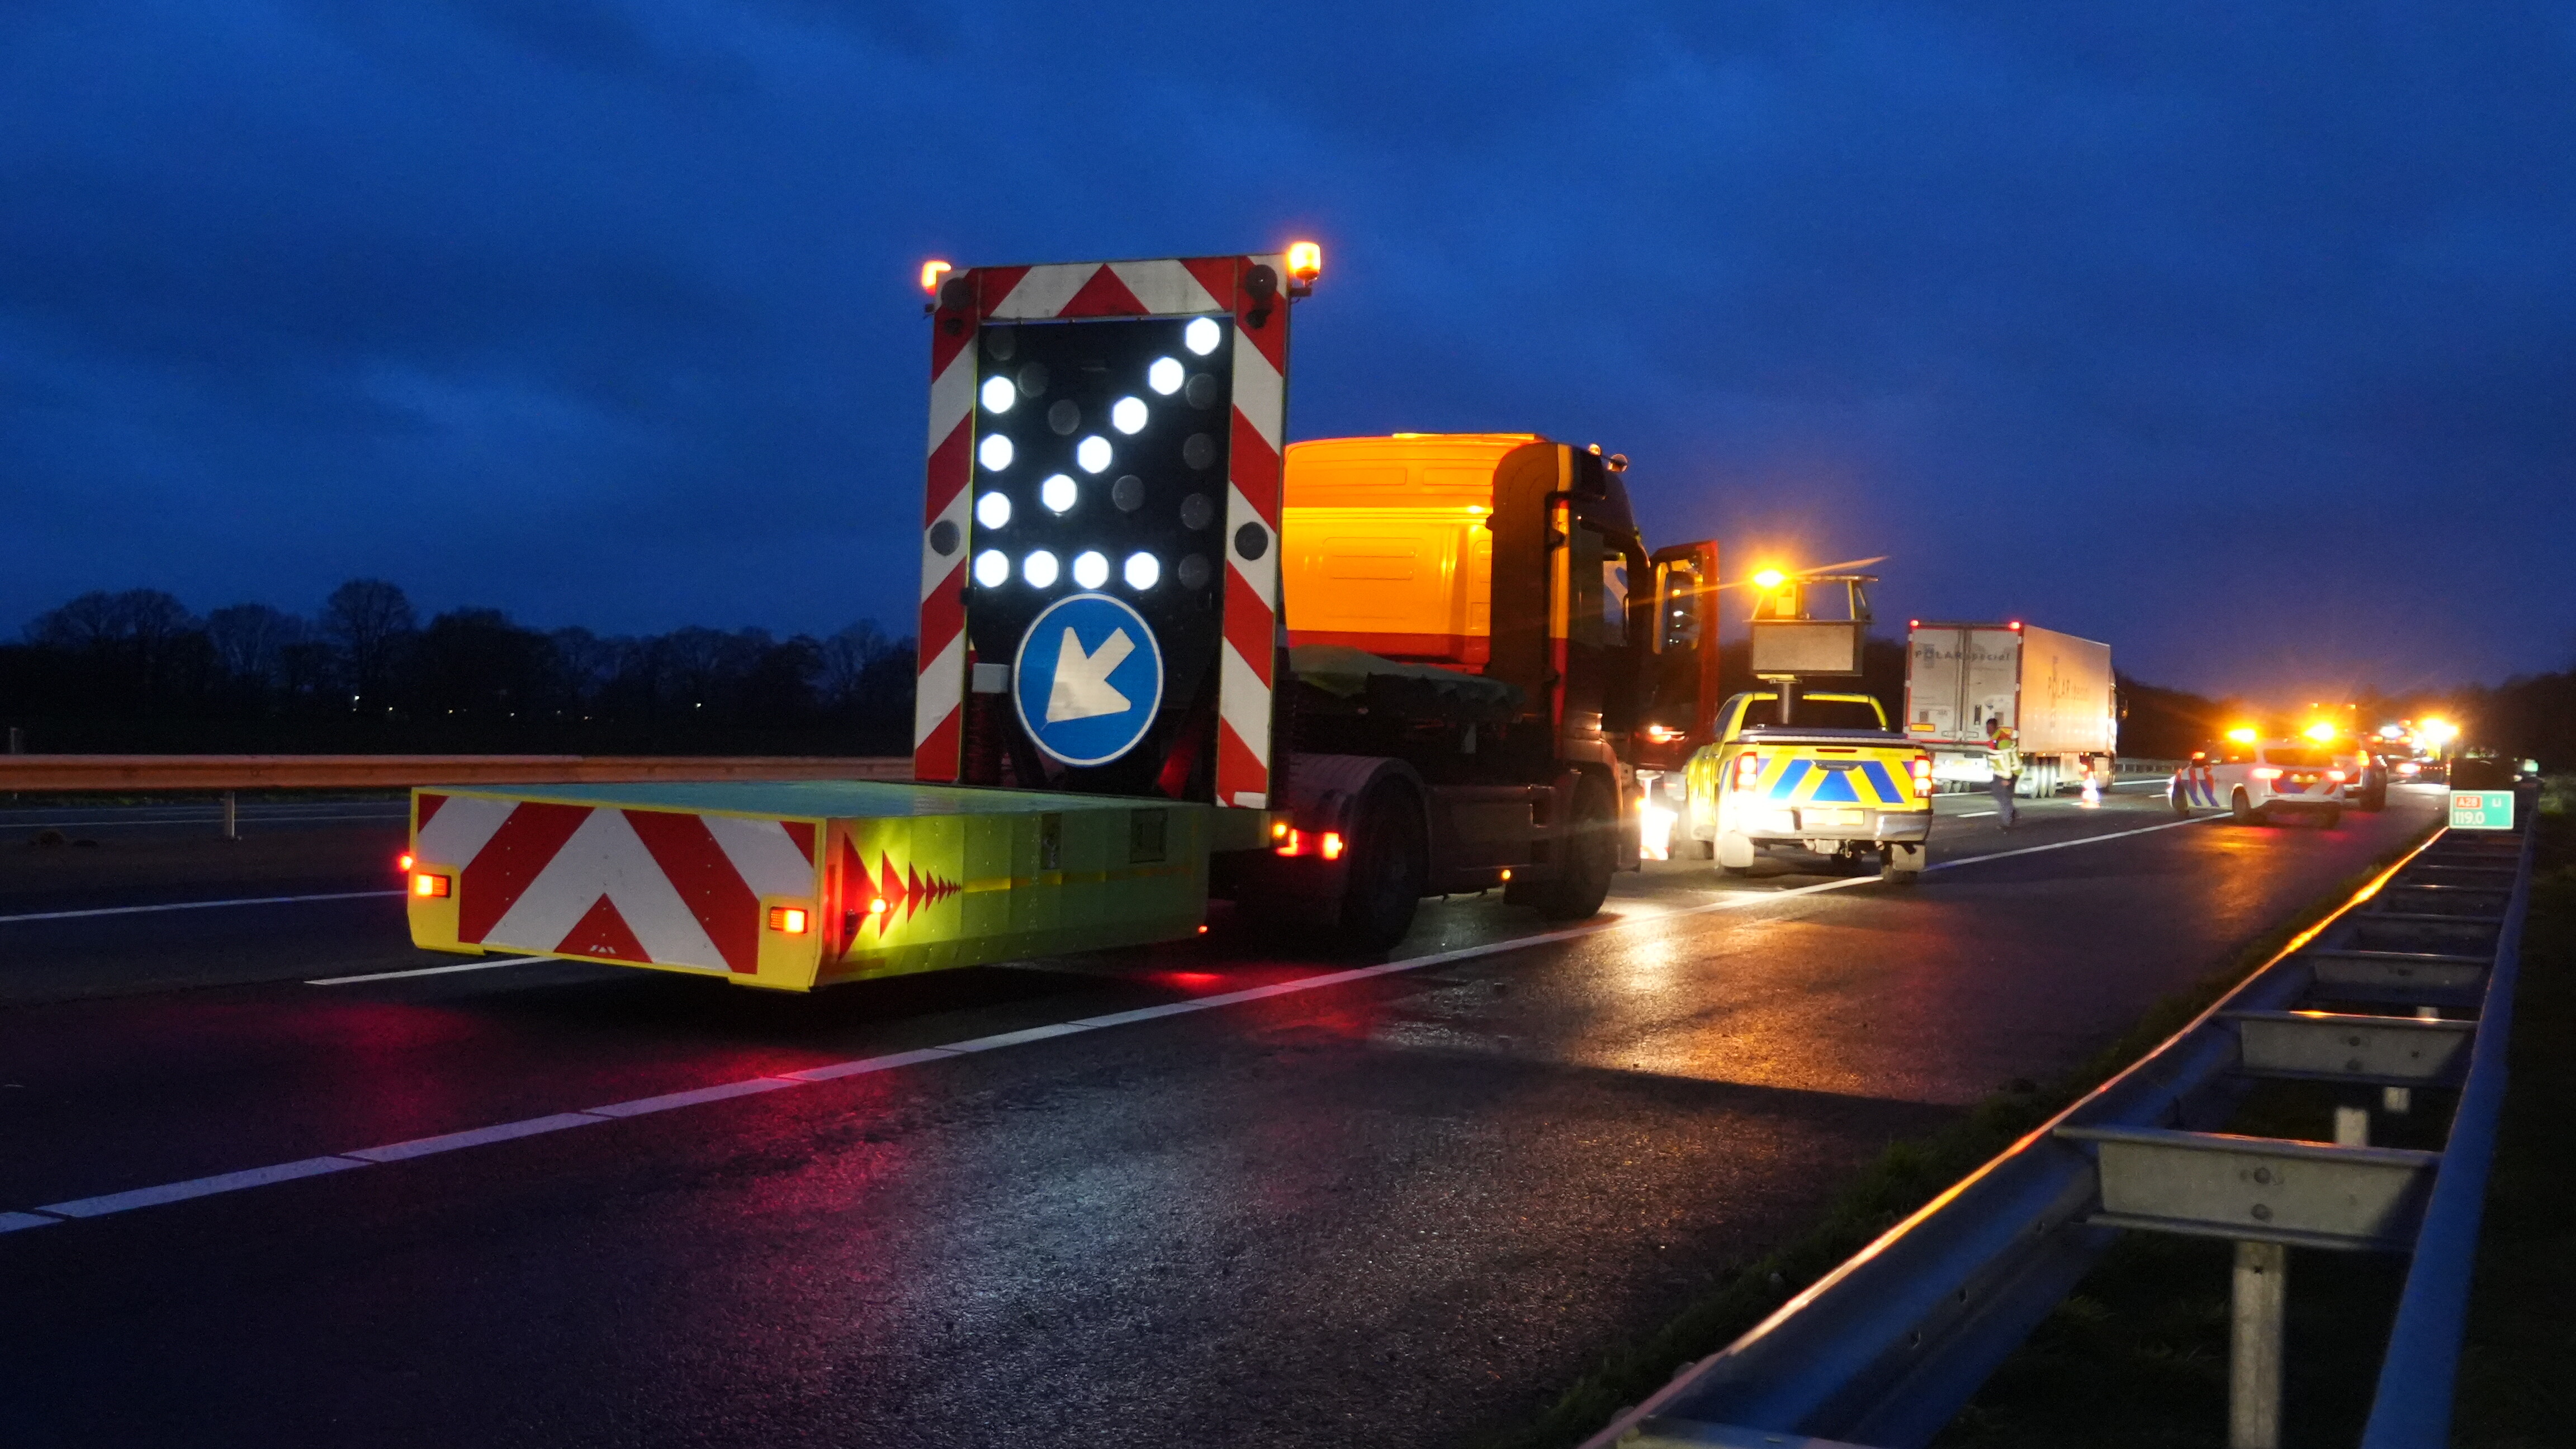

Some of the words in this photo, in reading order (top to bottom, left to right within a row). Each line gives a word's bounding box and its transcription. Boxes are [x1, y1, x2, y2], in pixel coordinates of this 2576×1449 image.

[1915, 648, 1962, 660] POLAR
[2048, 676, 2070, 699] POLAR
[2459, 798, 2478, 807] A28
[2455, 811, 2485, 825] 119.0
